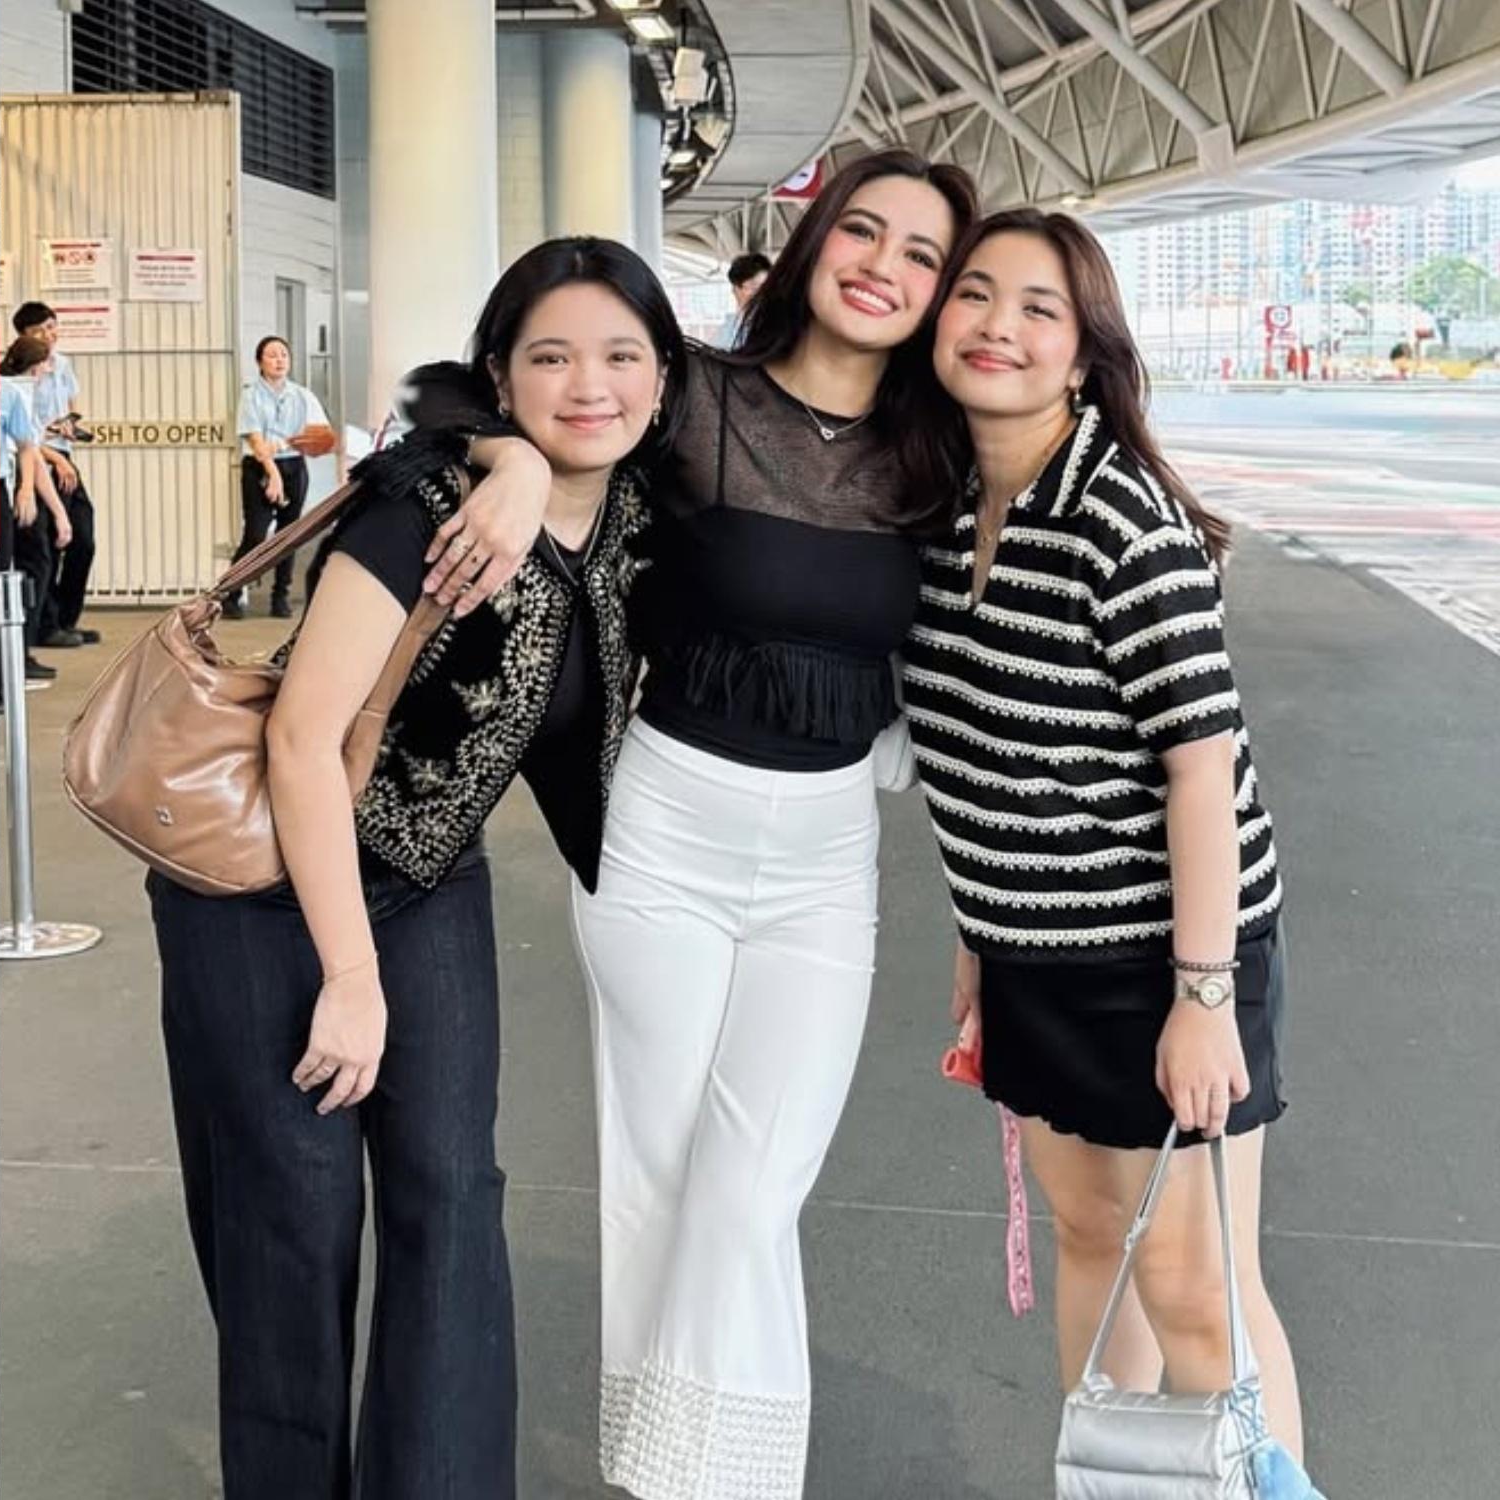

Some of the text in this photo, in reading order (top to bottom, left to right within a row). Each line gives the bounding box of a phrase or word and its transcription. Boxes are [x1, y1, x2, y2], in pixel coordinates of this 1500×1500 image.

[90, 425, 224, 443] SH TO OPEN
